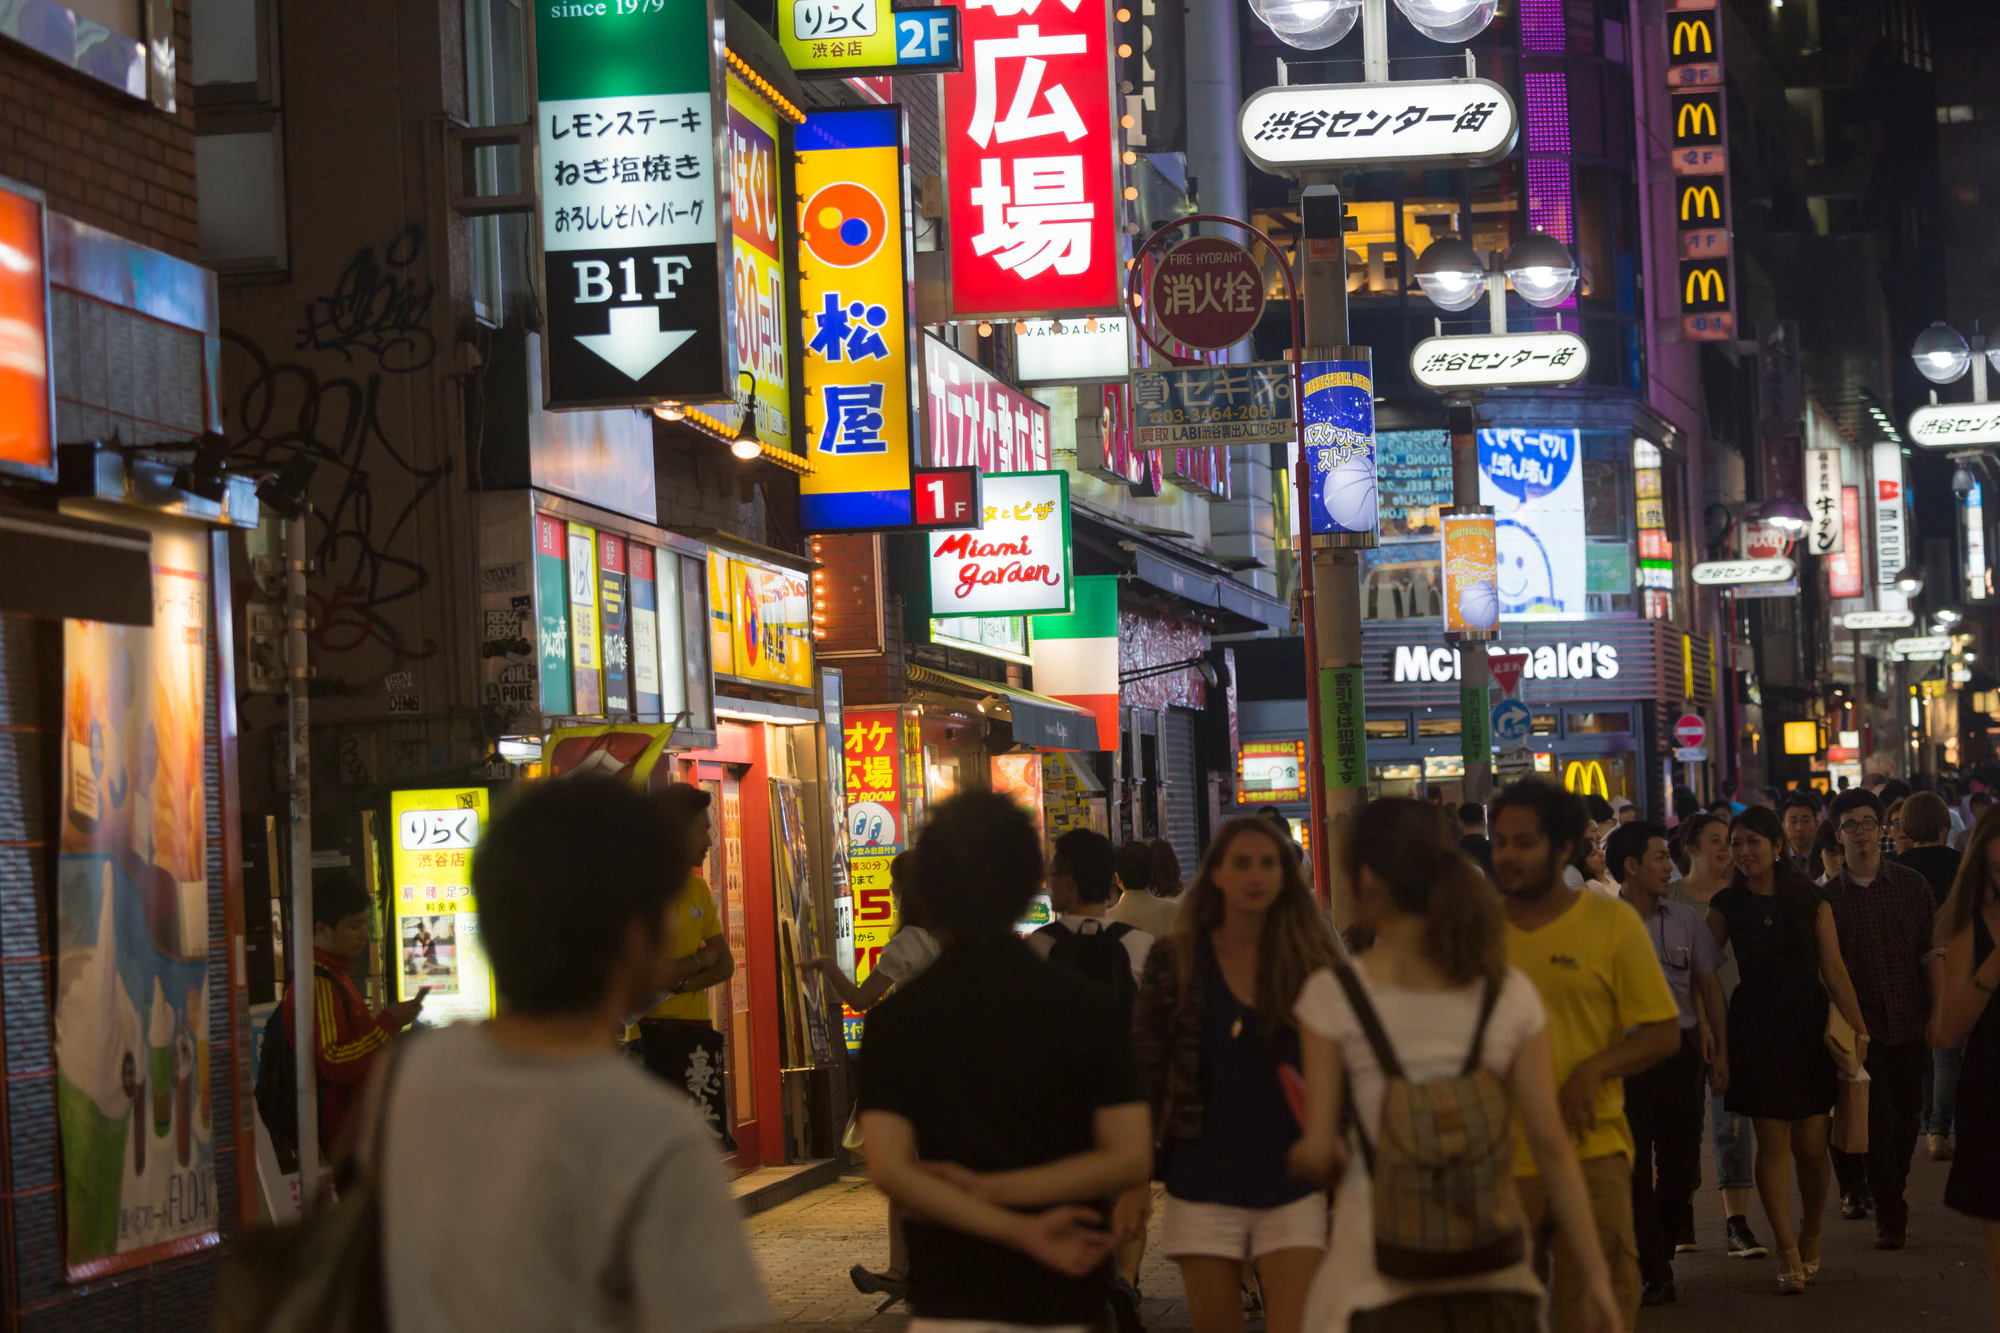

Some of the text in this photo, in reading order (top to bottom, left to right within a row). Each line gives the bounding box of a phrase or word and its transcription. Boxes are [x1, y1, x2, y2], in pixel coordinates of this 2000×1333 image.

[551, 0, 665, 19] since 1979
[805, 3, 867, 36] りらく
[812, 41, 862, 59] 渋谷店
[899, 17, 949, 59] 2F
[552, 107, 702, 140] レモンステーキ
[1254, 101, 1499, 141] 渋谷センター街
[967, 0, 1094, 281] 広場
[554, 154, 702, 186] ねぎ塩焼き
[730, 128, 777, 242] ほぐし
[555, 199, 705, 233] おろししそハンバーグ
[1170, 251, 1243, 265] FIRE HYDRANT
[573, 255, 692, 304] B1F
[1163, 270, 1256, 315] 消火栓
[1026, 323, 1120, 337] VANDALSM
[1421, 346, 1578, 373] 渋谷センター街
[808, 290, 891, 456] 松屋
[1174, 366, 1291, 406] セキネ
[1304, 372, 1352, 398] BASKETBALL
[1163, 403, 1277, 423] 03-3464-2061
[1141, 427, 1169, 443] 買取
[1305, 423, 1374, 446] バスケットボー
[1318, 446, 1370, 471] ストリート
[1816, 496, 1838, 550] 牛タン
[934, 533, 1033, 559] Miami
[572, 550, 592, 597] りらく
[954, 561, 1060, 600] garden
[486, 611, 520, 625] REKA
[487, 624, 521, 637] REKA
[1394, 641, 1620, 682] Mcnald's
[1494, 662, 1521, 673] 止まれ
[502, 685, 532, 701] POKE
[859, 790, 896, 802] ROOM
[411, 816, 471, 846] りらく
[418, 852, 466, 868] 渋谷店
[425, 902, 458, 912] 料金表
[853, 932, 876, 942] から
